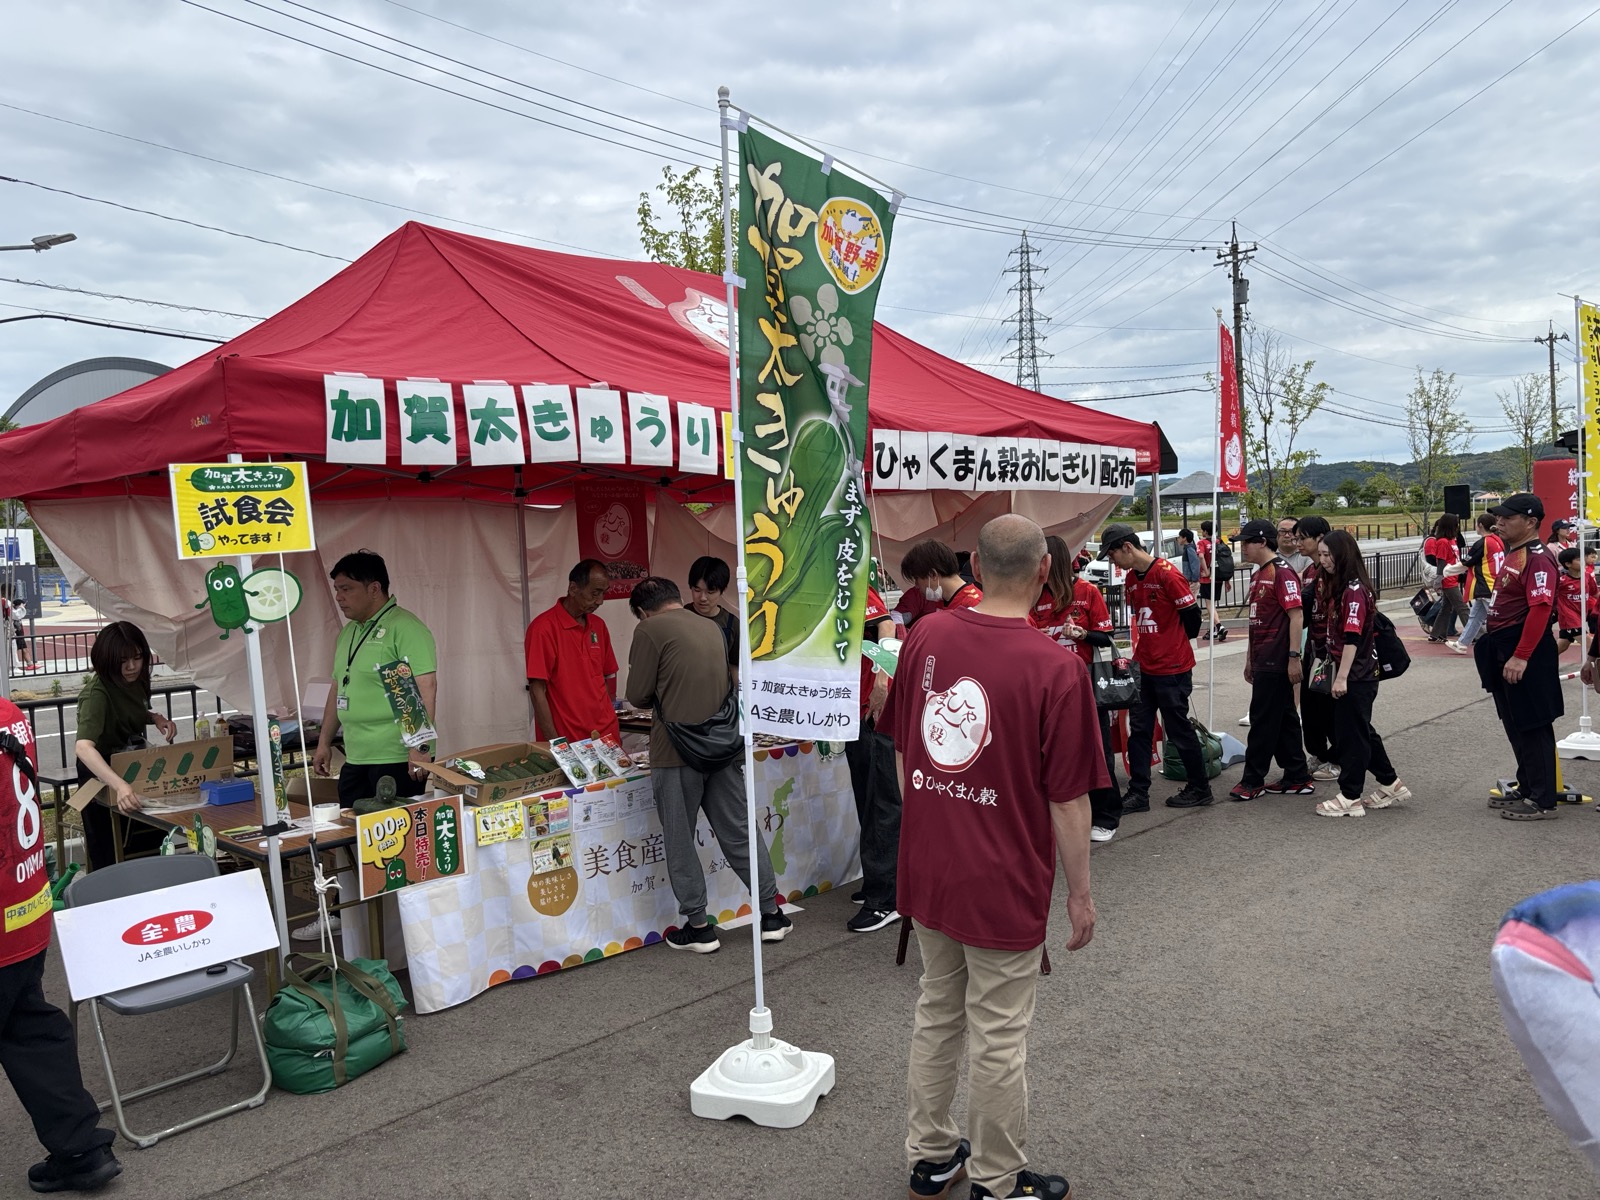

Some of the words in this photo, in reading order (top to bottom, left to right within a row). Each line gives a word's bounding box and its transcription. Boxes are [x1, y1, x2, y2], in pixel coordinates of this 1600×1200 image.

[330, 388, 711, 456] 加賀太きゅうり
[875, 441, 1136, 489] ひゃくまん穀おにぎり配布
[198, 495, 295, 532] 試食会
[761, 679, 852, 700] 加賀太きゅうり部会
[750, 704, 851, 727] A全農いしかわ
[13, 756, 40, 850] 8
[926, 775, 998, 807] ひゃくまん穀
[363, 816, 407, 847] 100円
[413, 807, 431, 880] 本日特売！
[16, 850, 44, 883] OYAMA
[138, 937, 211, 963] JA全農いしかわ
